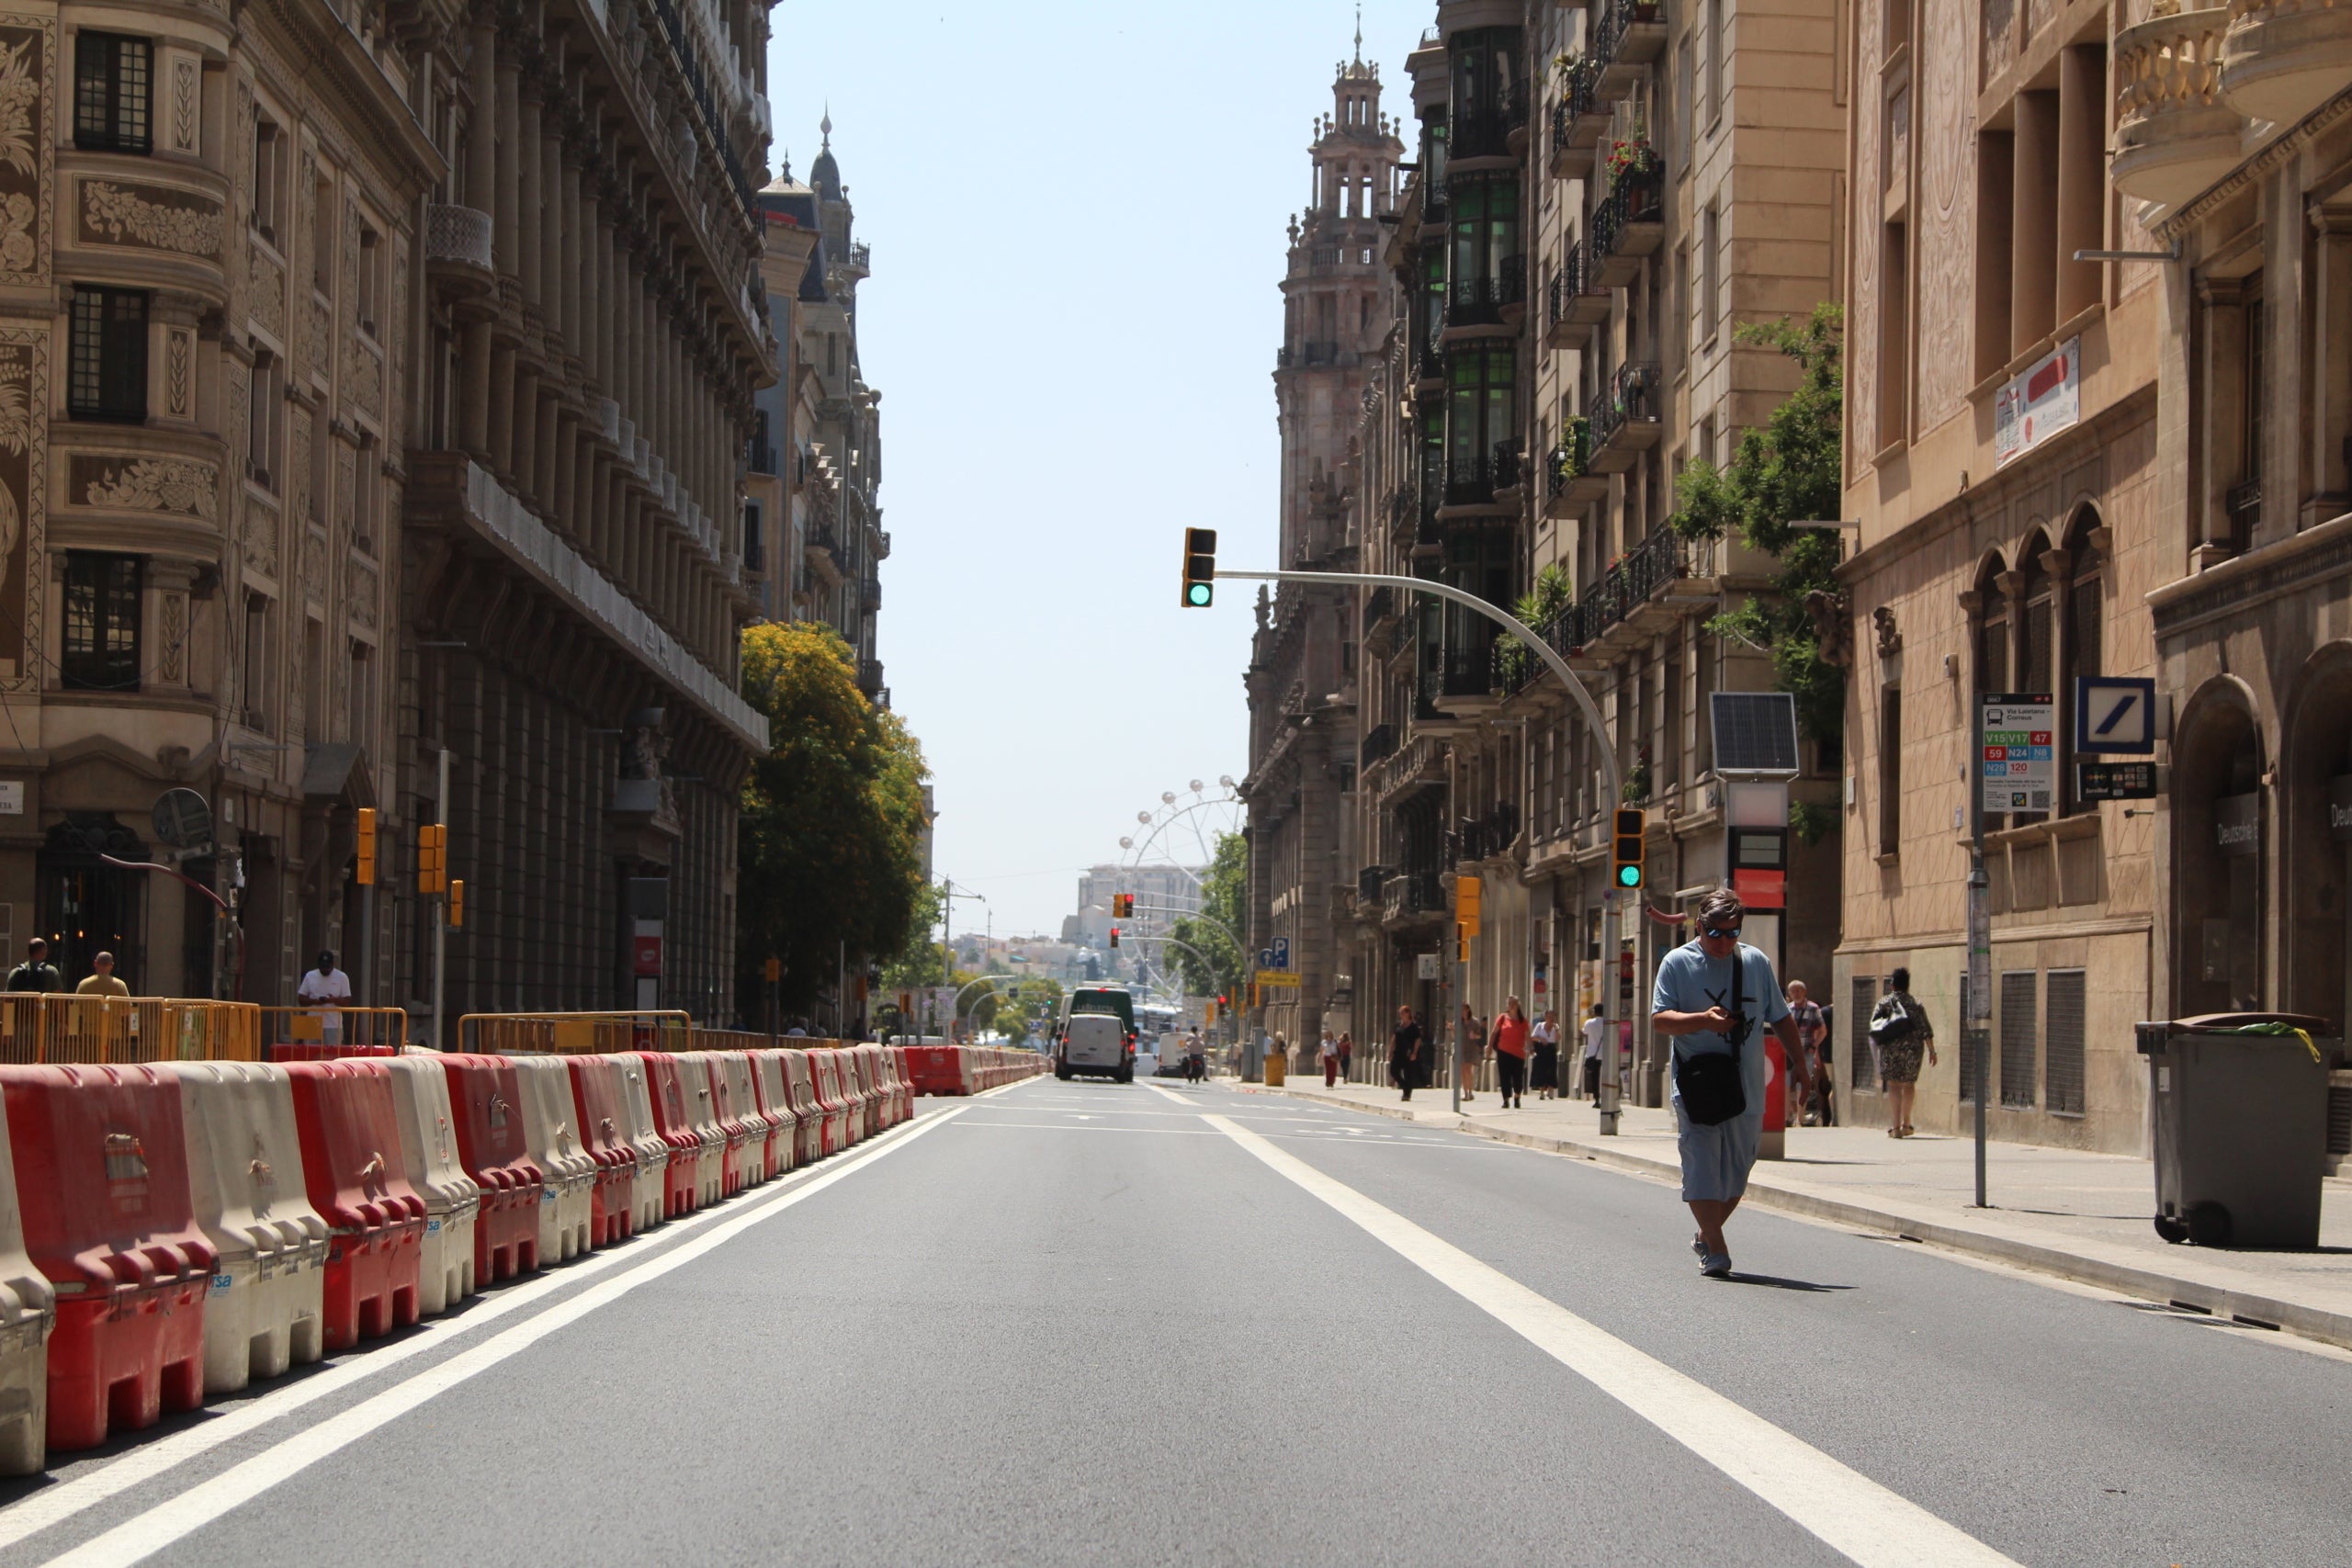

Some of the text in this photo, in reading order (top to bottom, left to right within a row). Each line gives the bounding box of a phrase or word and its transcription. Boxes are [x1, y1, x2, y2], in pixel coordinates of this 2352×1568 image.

[1985, 734, 2047, 743] V15 V17 47
[1989, 748, 2047, 758] 59 N24 N8
[1986, 763, 2006, 772] N28
[2217, 821, 2253, 845] Deutsche
[1275, 939, 1286, 956] P
